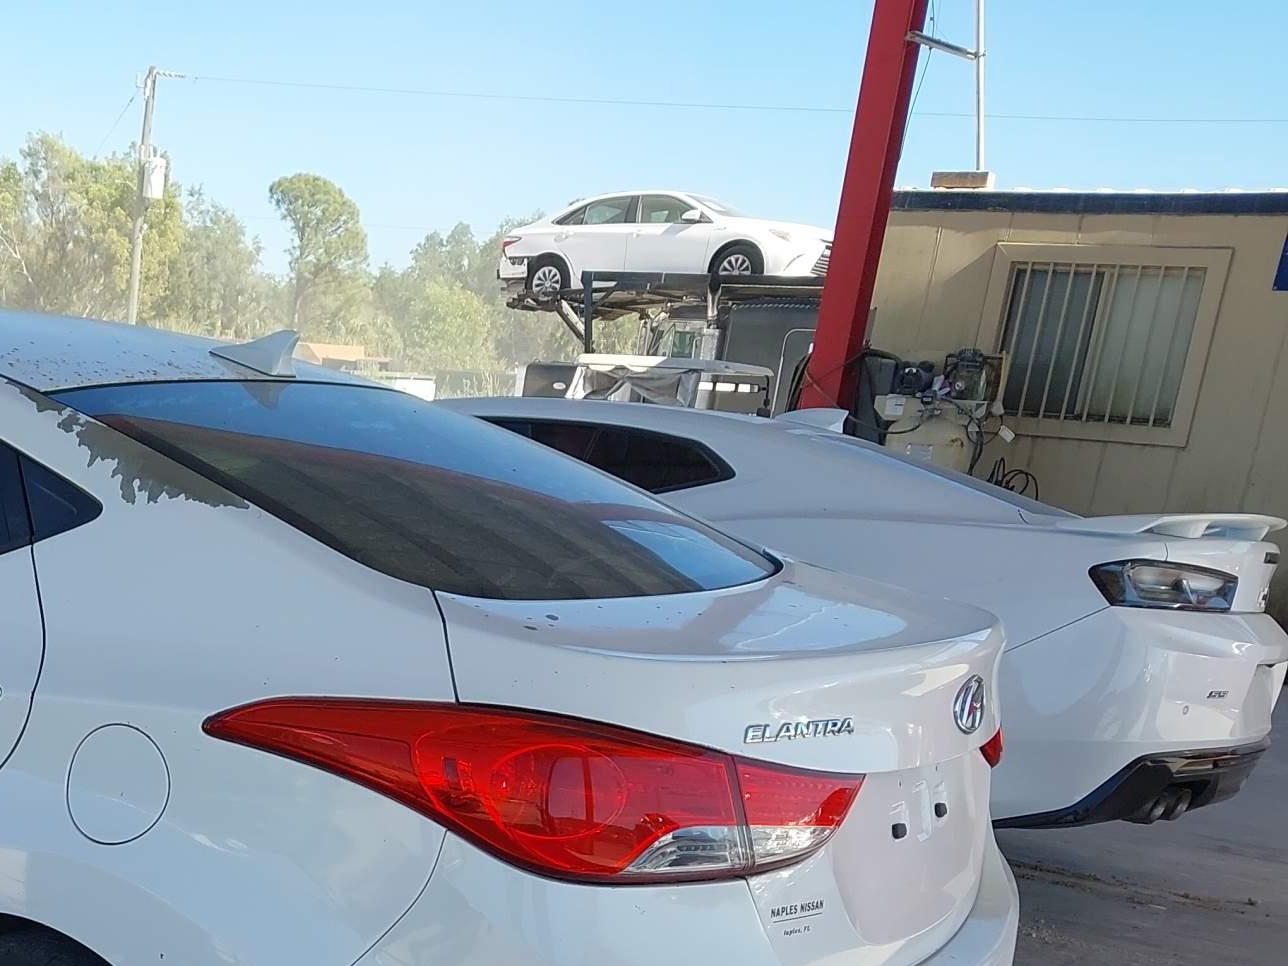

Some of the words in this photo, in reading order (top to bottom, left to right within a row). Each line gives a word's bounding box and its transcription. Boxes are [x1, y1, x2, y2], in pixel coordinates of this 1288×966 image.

[744, 717, 854, 743] ELANTRA
[770, 904, 798, 918] NAPLES
[800, 899, 824, 913] NISSAN
